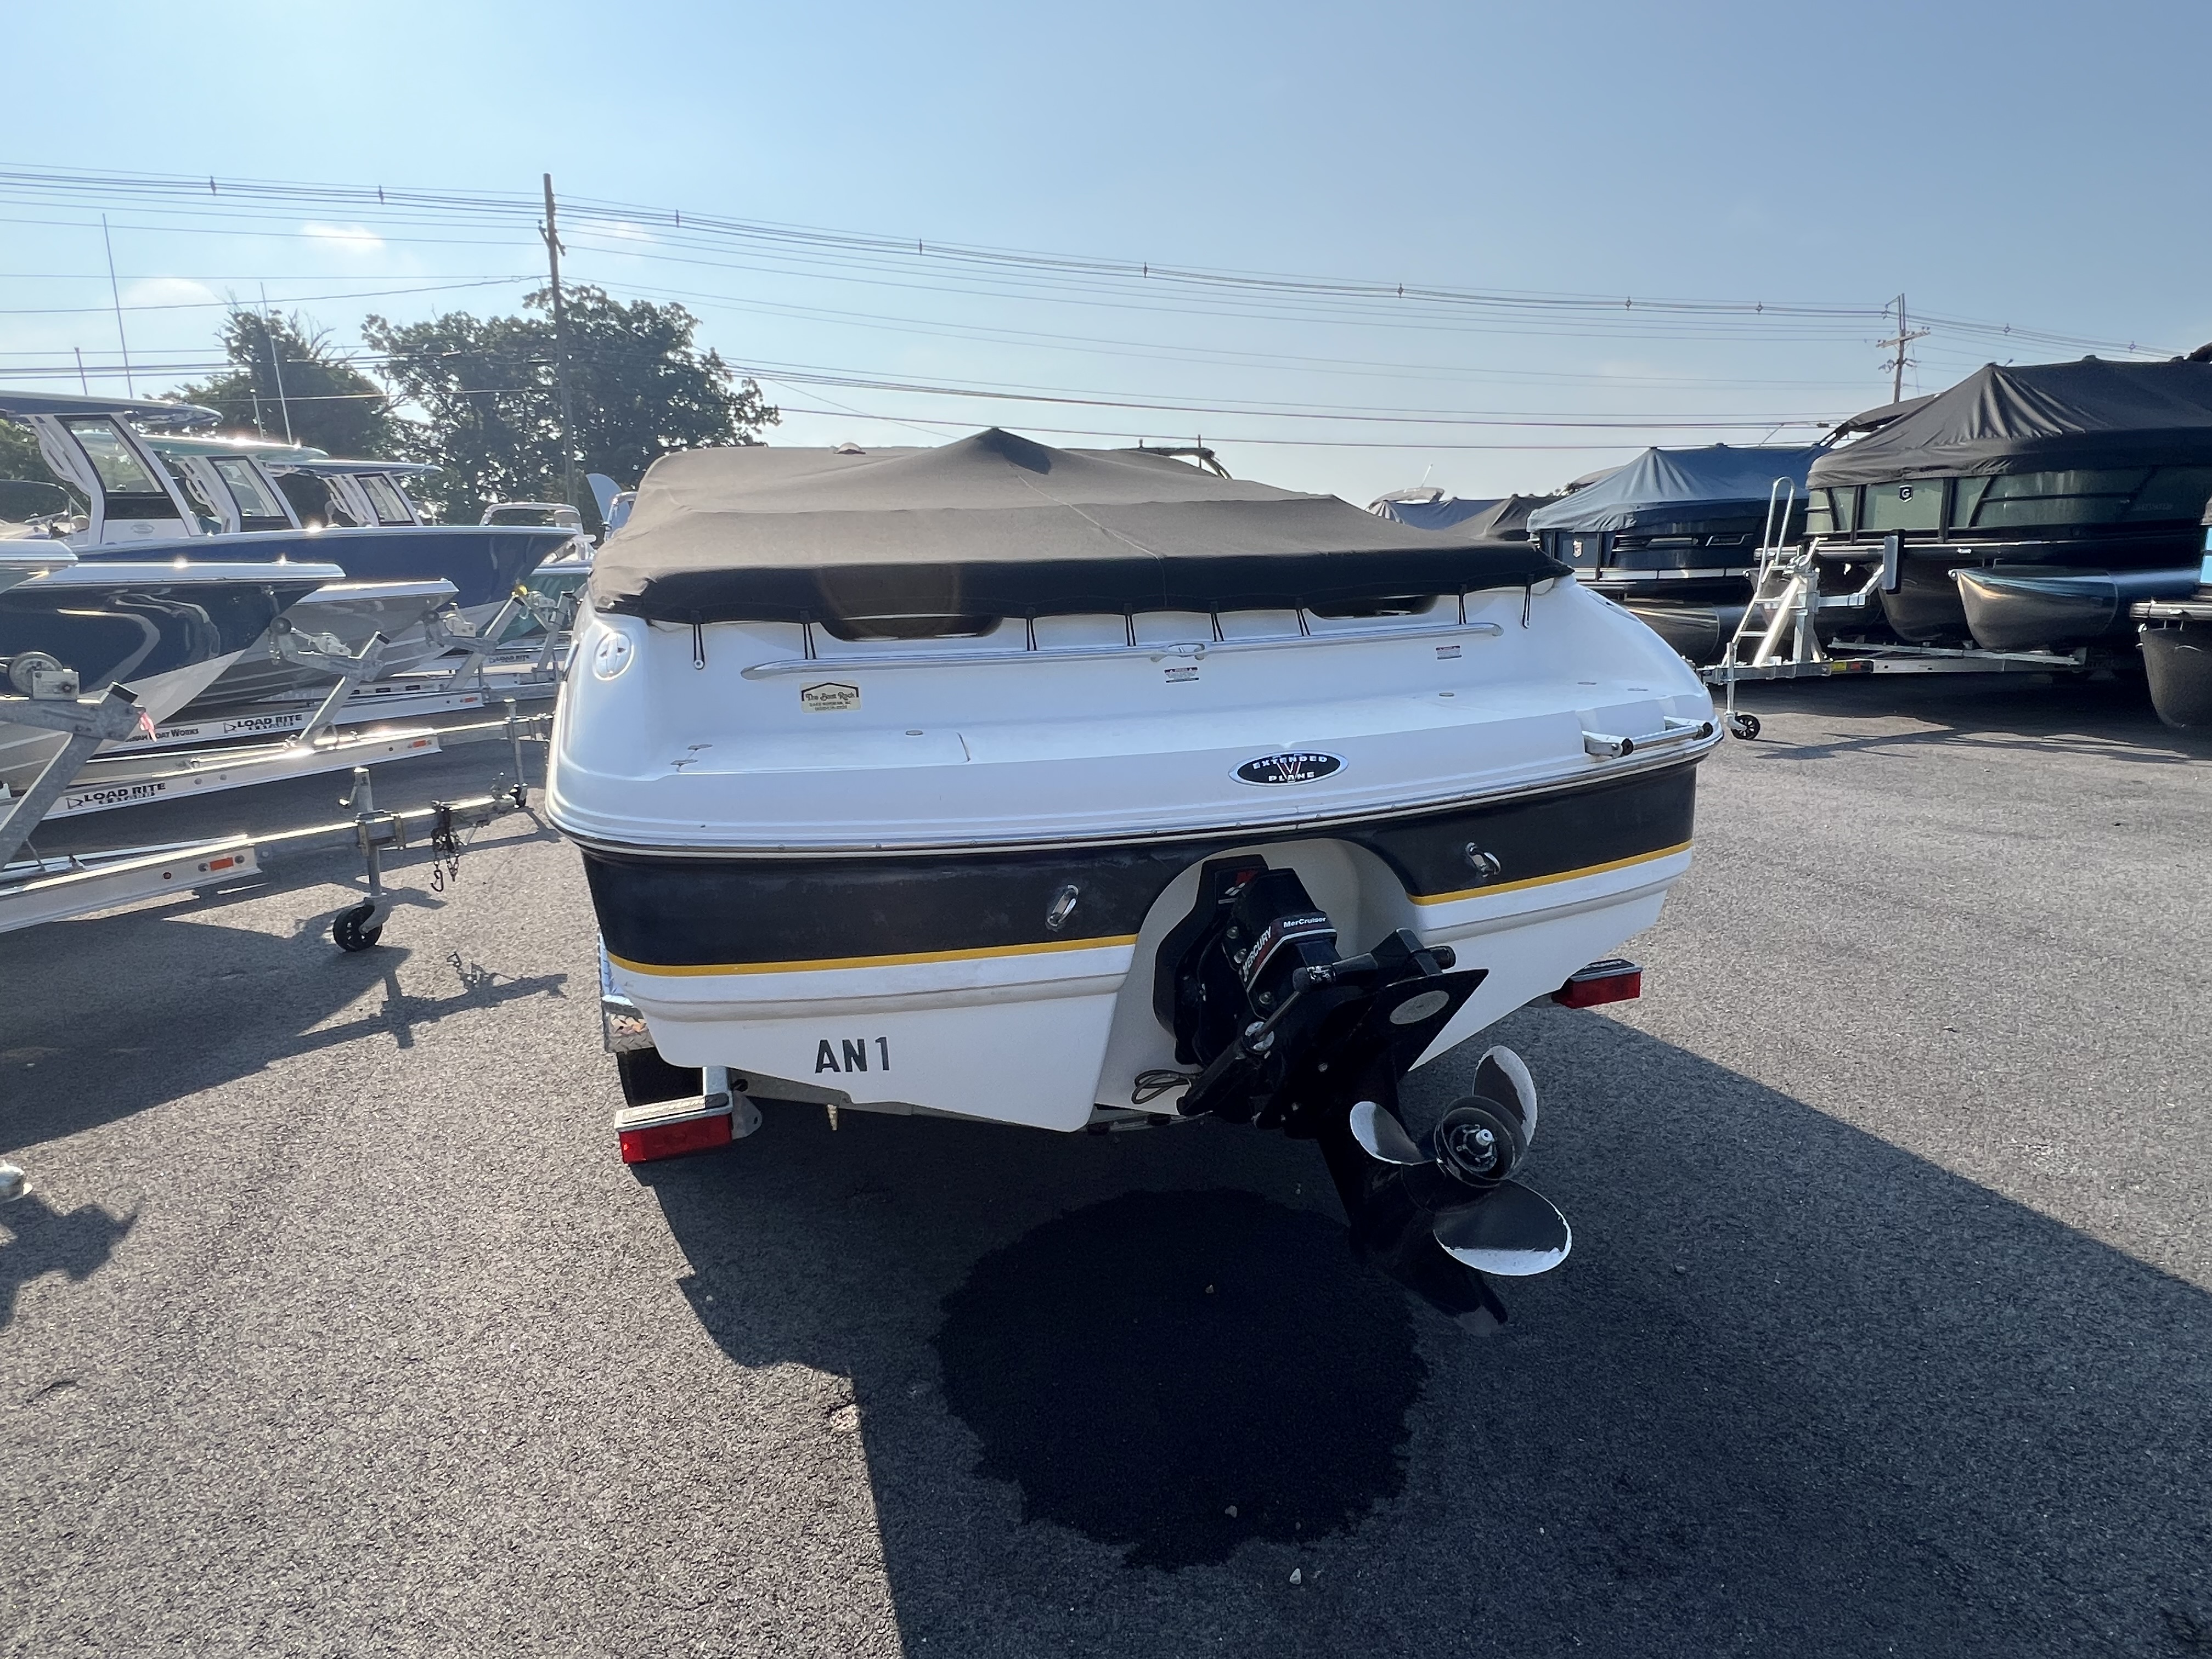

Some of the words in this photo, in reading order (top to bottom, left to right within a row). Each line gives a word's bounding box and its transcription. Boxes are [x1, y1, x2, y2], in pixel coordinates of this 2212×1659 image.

[1901, 488, 1910, 498] G
[237, 718, 272, 727] LOAD
[275, 714, 302, 723] RITE
[1252, 756, 1328, 769] EXTENDED
[1268, 771, 1315, 782] PLANE
[83, 789, 128, 802] LOAD
[132, 782, 166, 794] RITE
[1283, 917, 1327, 928] MerCruiser
[815, 1039, 868, 1074] AN
